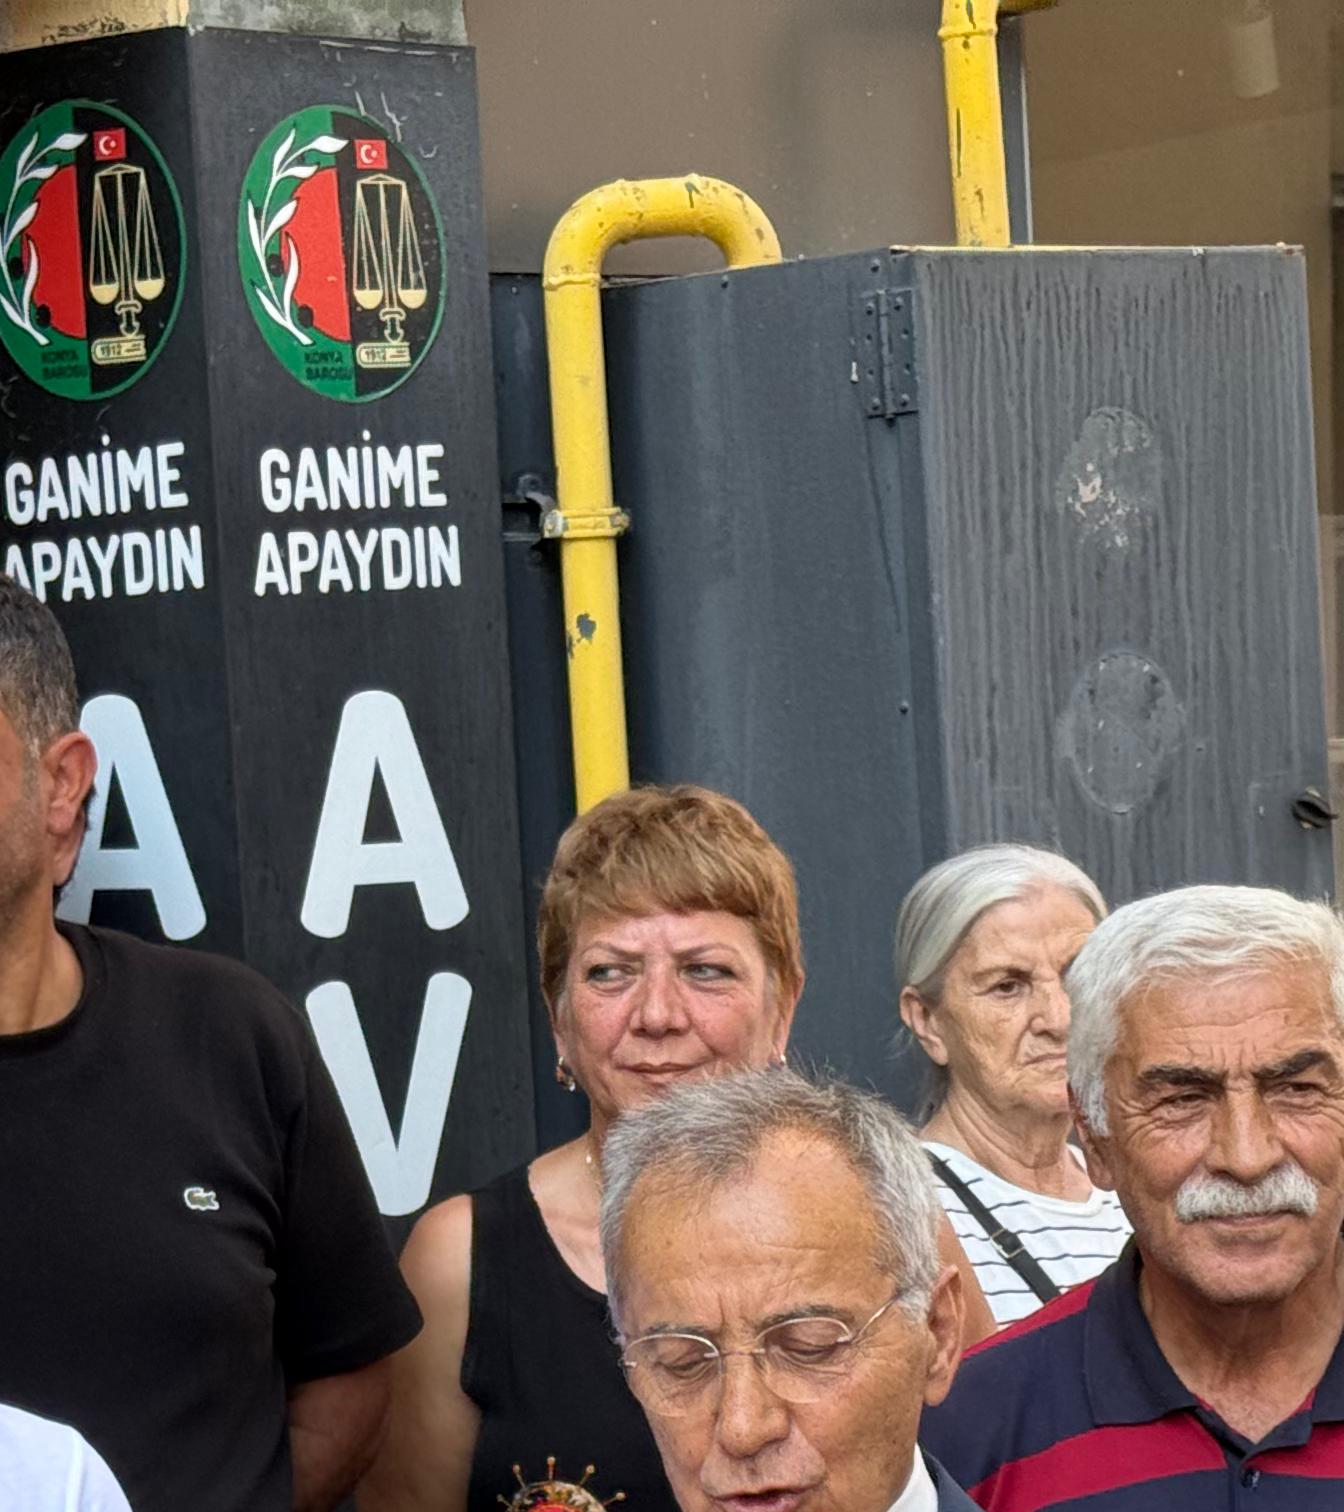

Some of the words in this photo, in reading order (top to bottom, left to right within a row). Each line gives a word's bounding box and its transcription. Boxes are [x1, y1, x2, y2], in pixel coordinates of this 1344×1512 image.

[4, 434, 189, 527] GANİME
[259, 429, 448, 514] GANİME
[253, 525, 462, 597] APAYDIN
